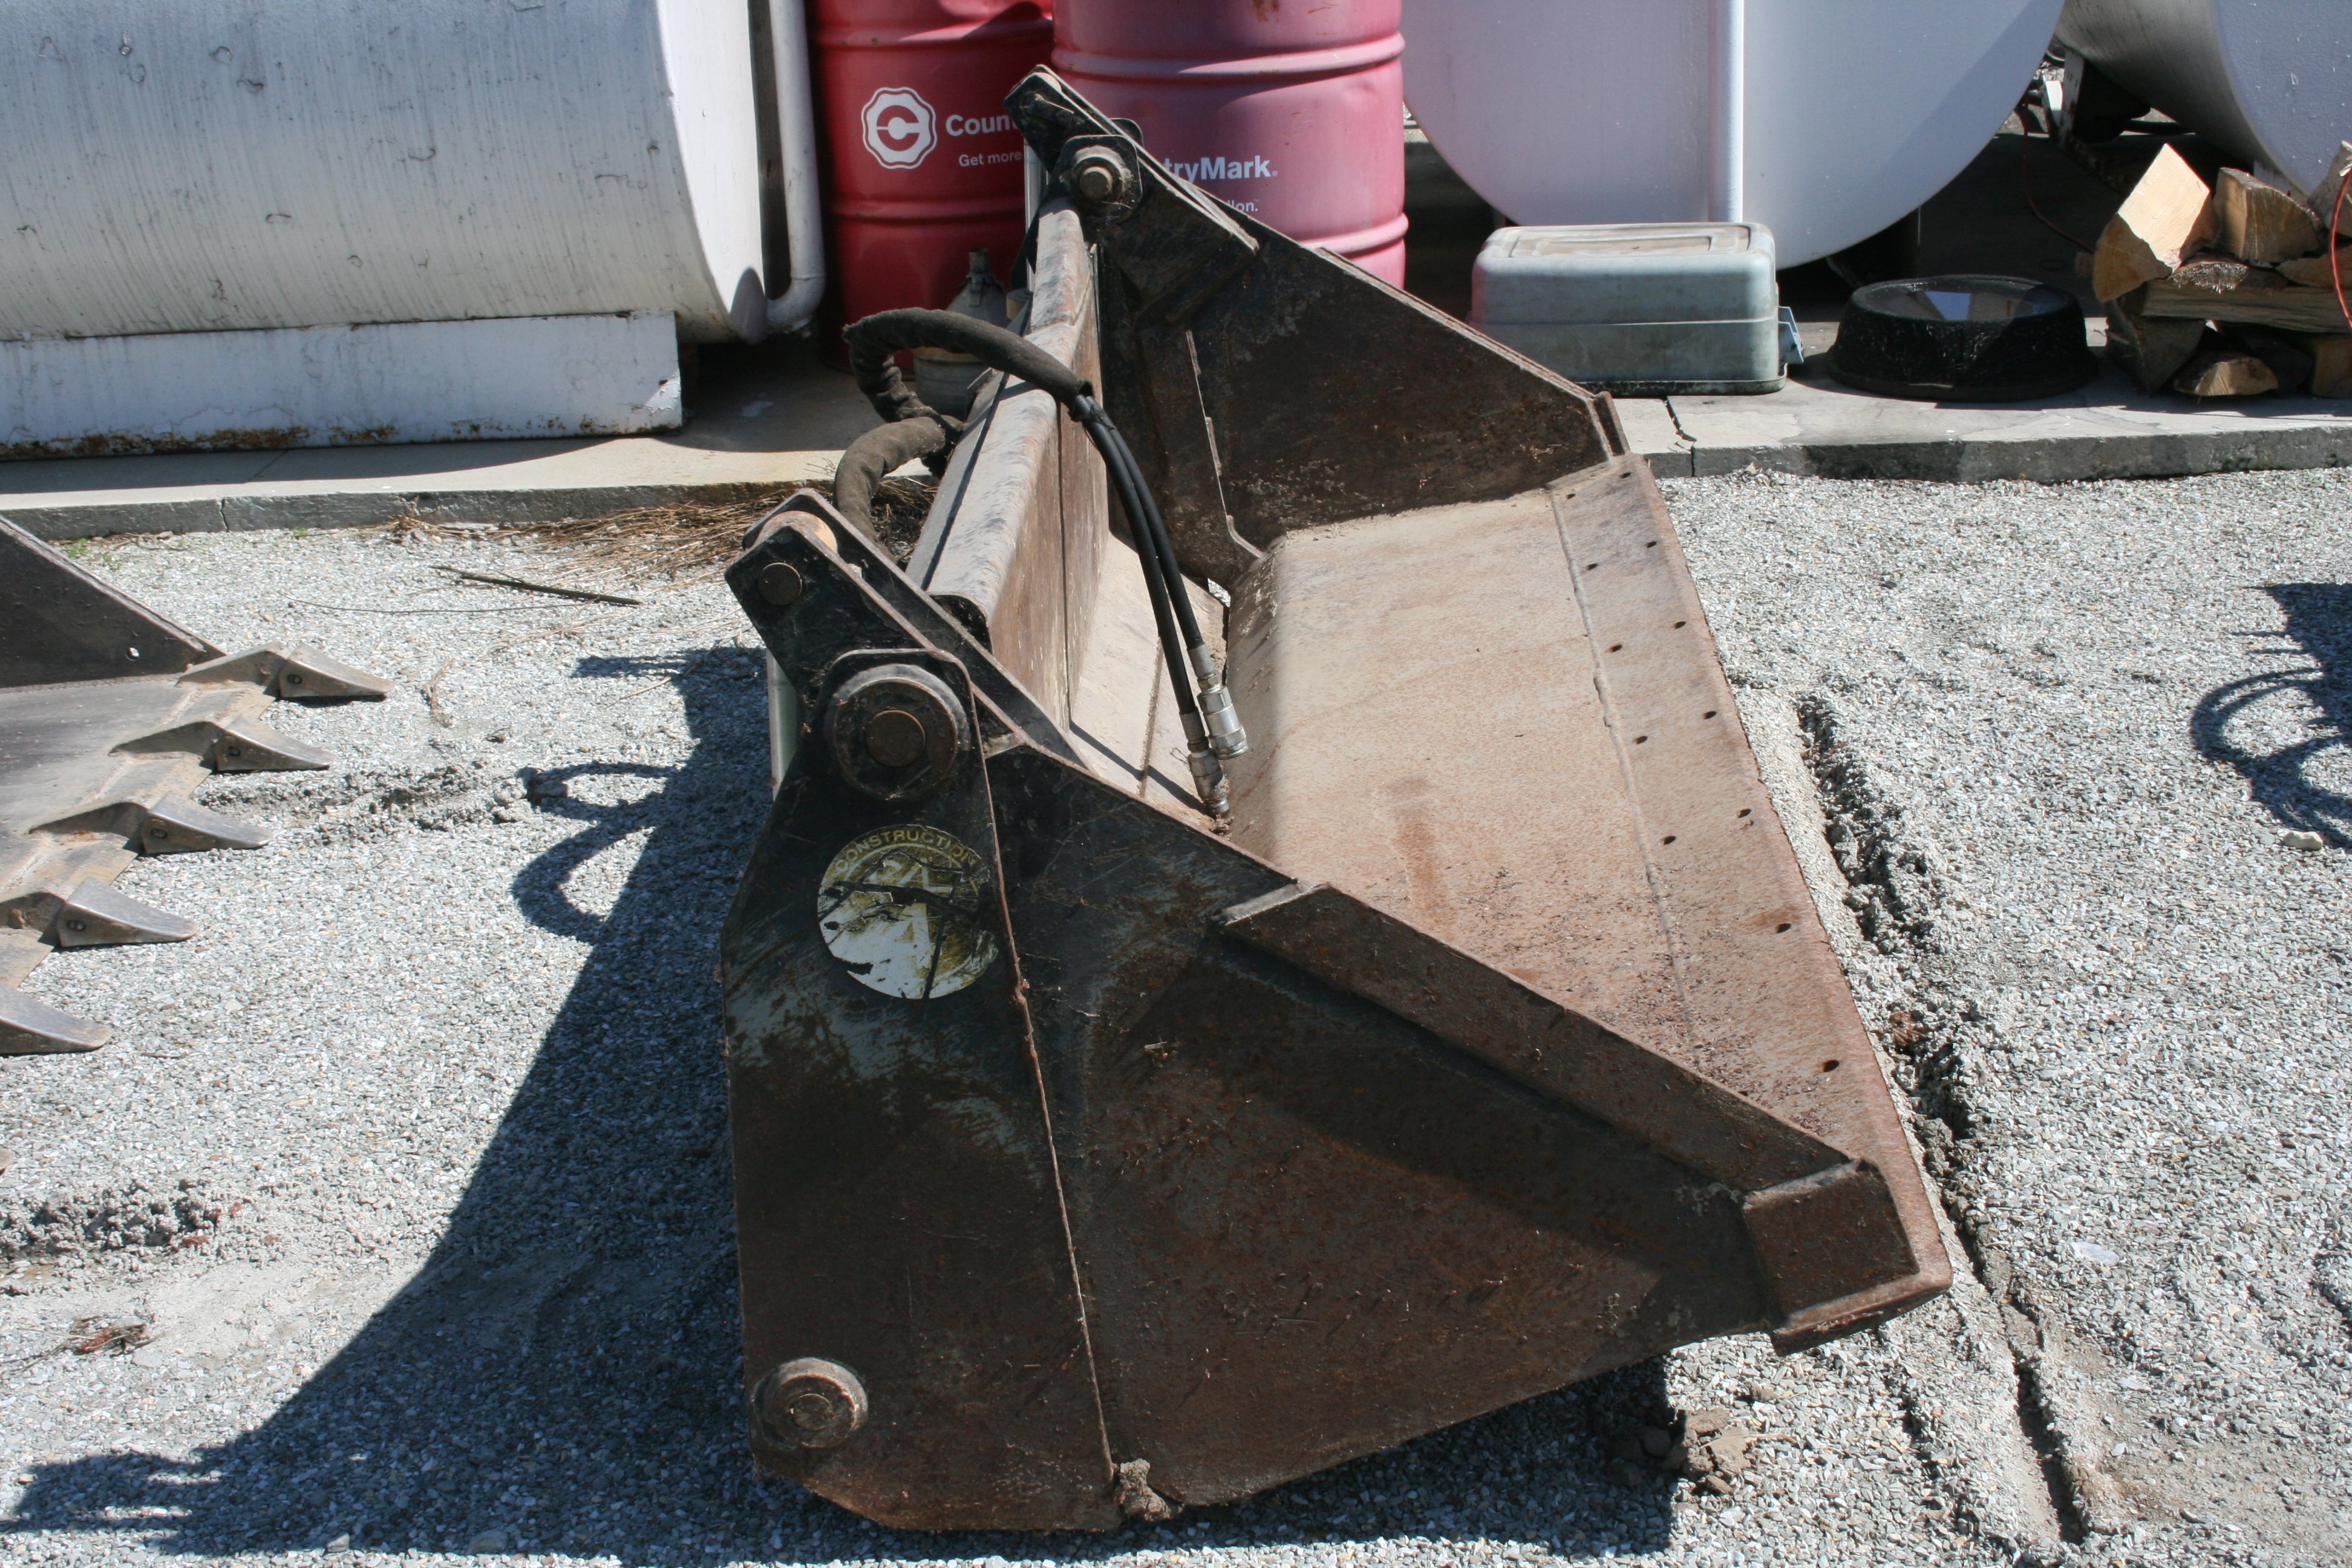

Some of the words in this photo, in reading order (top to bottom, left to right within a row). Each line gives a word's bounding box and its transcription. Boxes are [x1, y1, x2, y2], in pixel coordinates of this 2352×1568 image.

[959, 154, 984, 167] Get
[988, 152, 1022, 164] more
[835, 829, 979, 872] CONSTRUCTION
